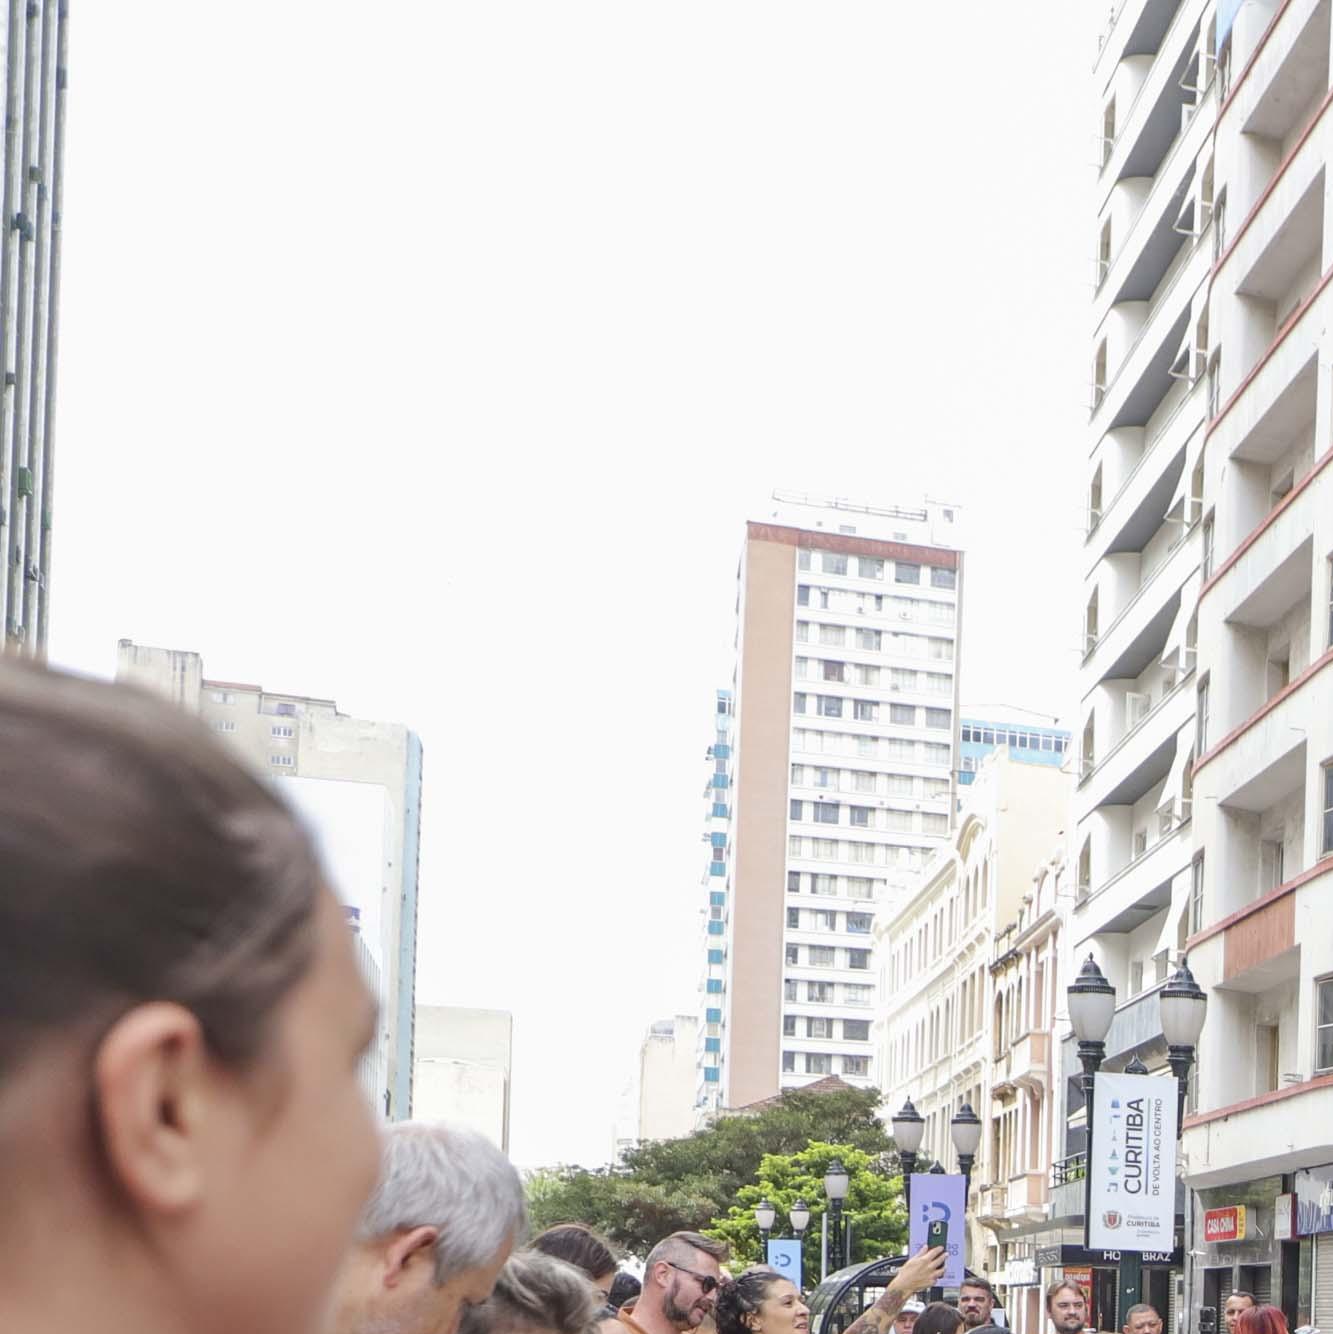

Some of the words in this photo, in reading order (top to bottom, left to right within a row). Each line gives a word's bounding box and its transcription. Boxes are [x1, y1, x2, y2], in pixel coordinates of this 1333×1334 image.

[1153, 1098, 1162, 1137] CENTRO
[1123, 1098, 1144, 1194] CURITIBA
[1152, 1154, 1160, 1181] VOLTA
